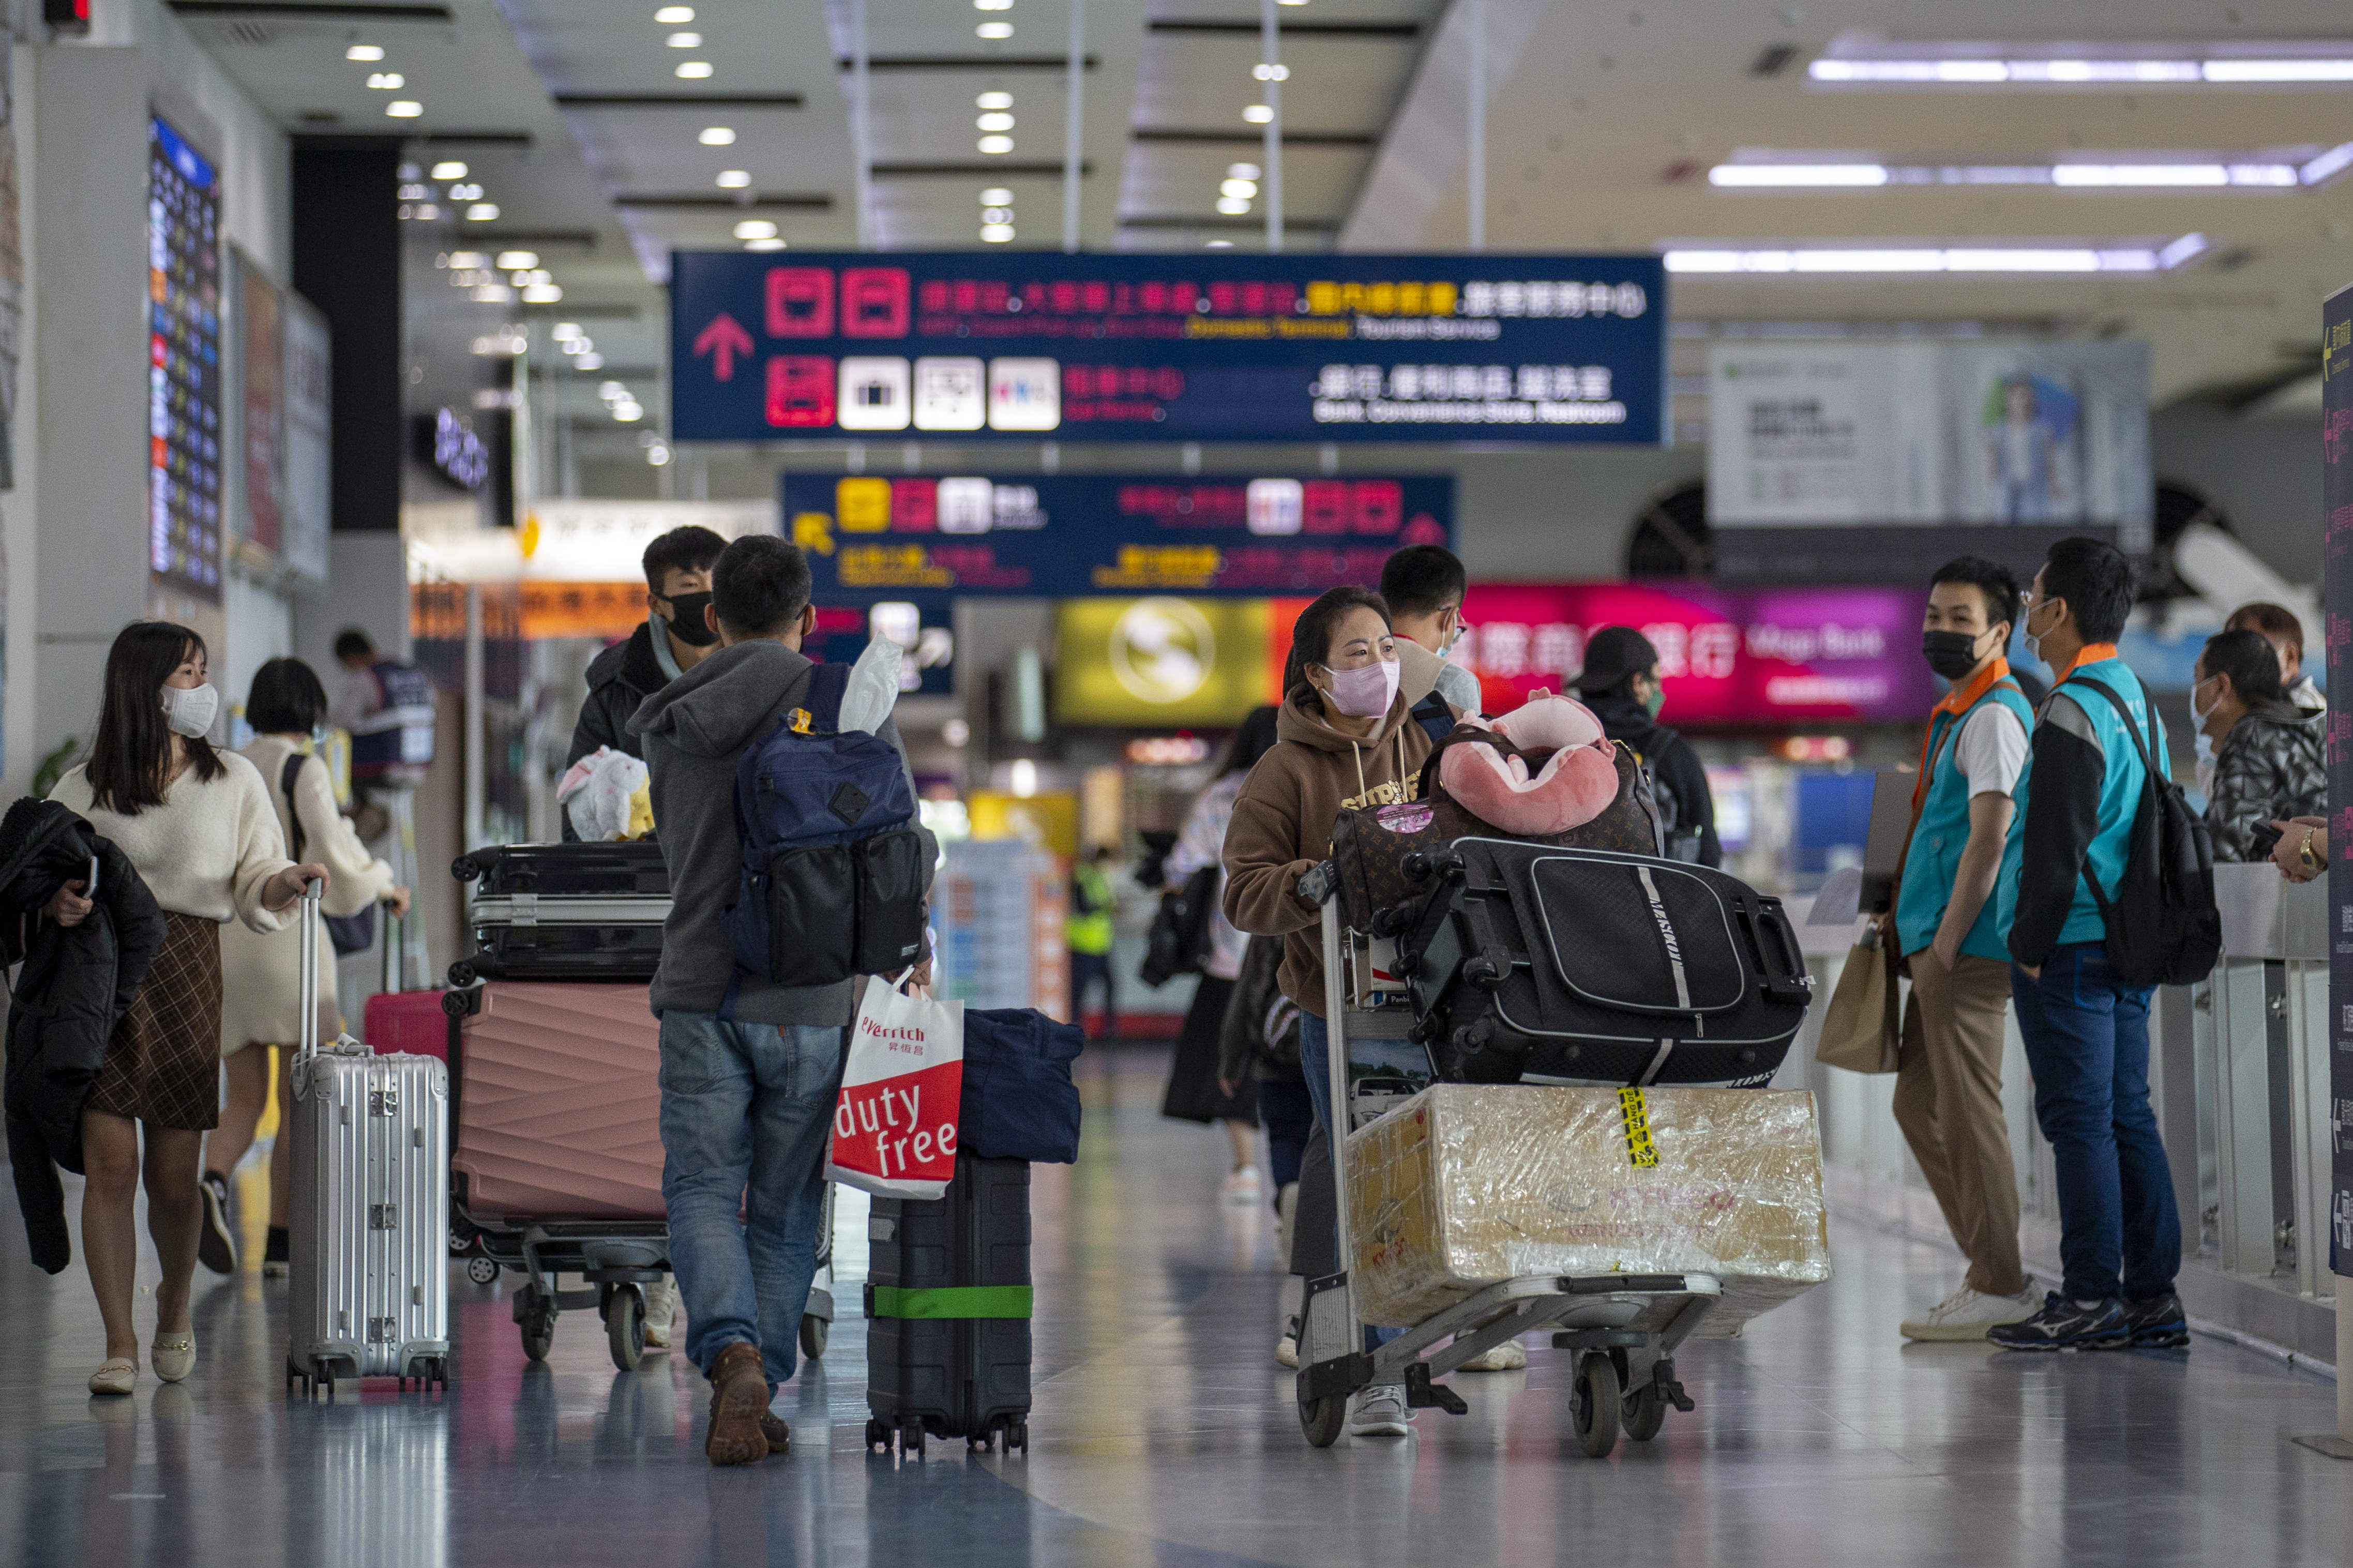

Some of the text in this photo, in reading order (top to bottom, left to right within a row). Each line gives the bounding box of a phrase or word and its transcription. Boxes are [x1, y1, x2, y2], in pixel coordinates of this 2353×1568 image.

[861, 1016, 925, 1042] everrich
[889, 1042, 924, 1056] 昇恆昌
[836, 1085, 919, 1138] duty
[876, 1123, 957, 1177] free
